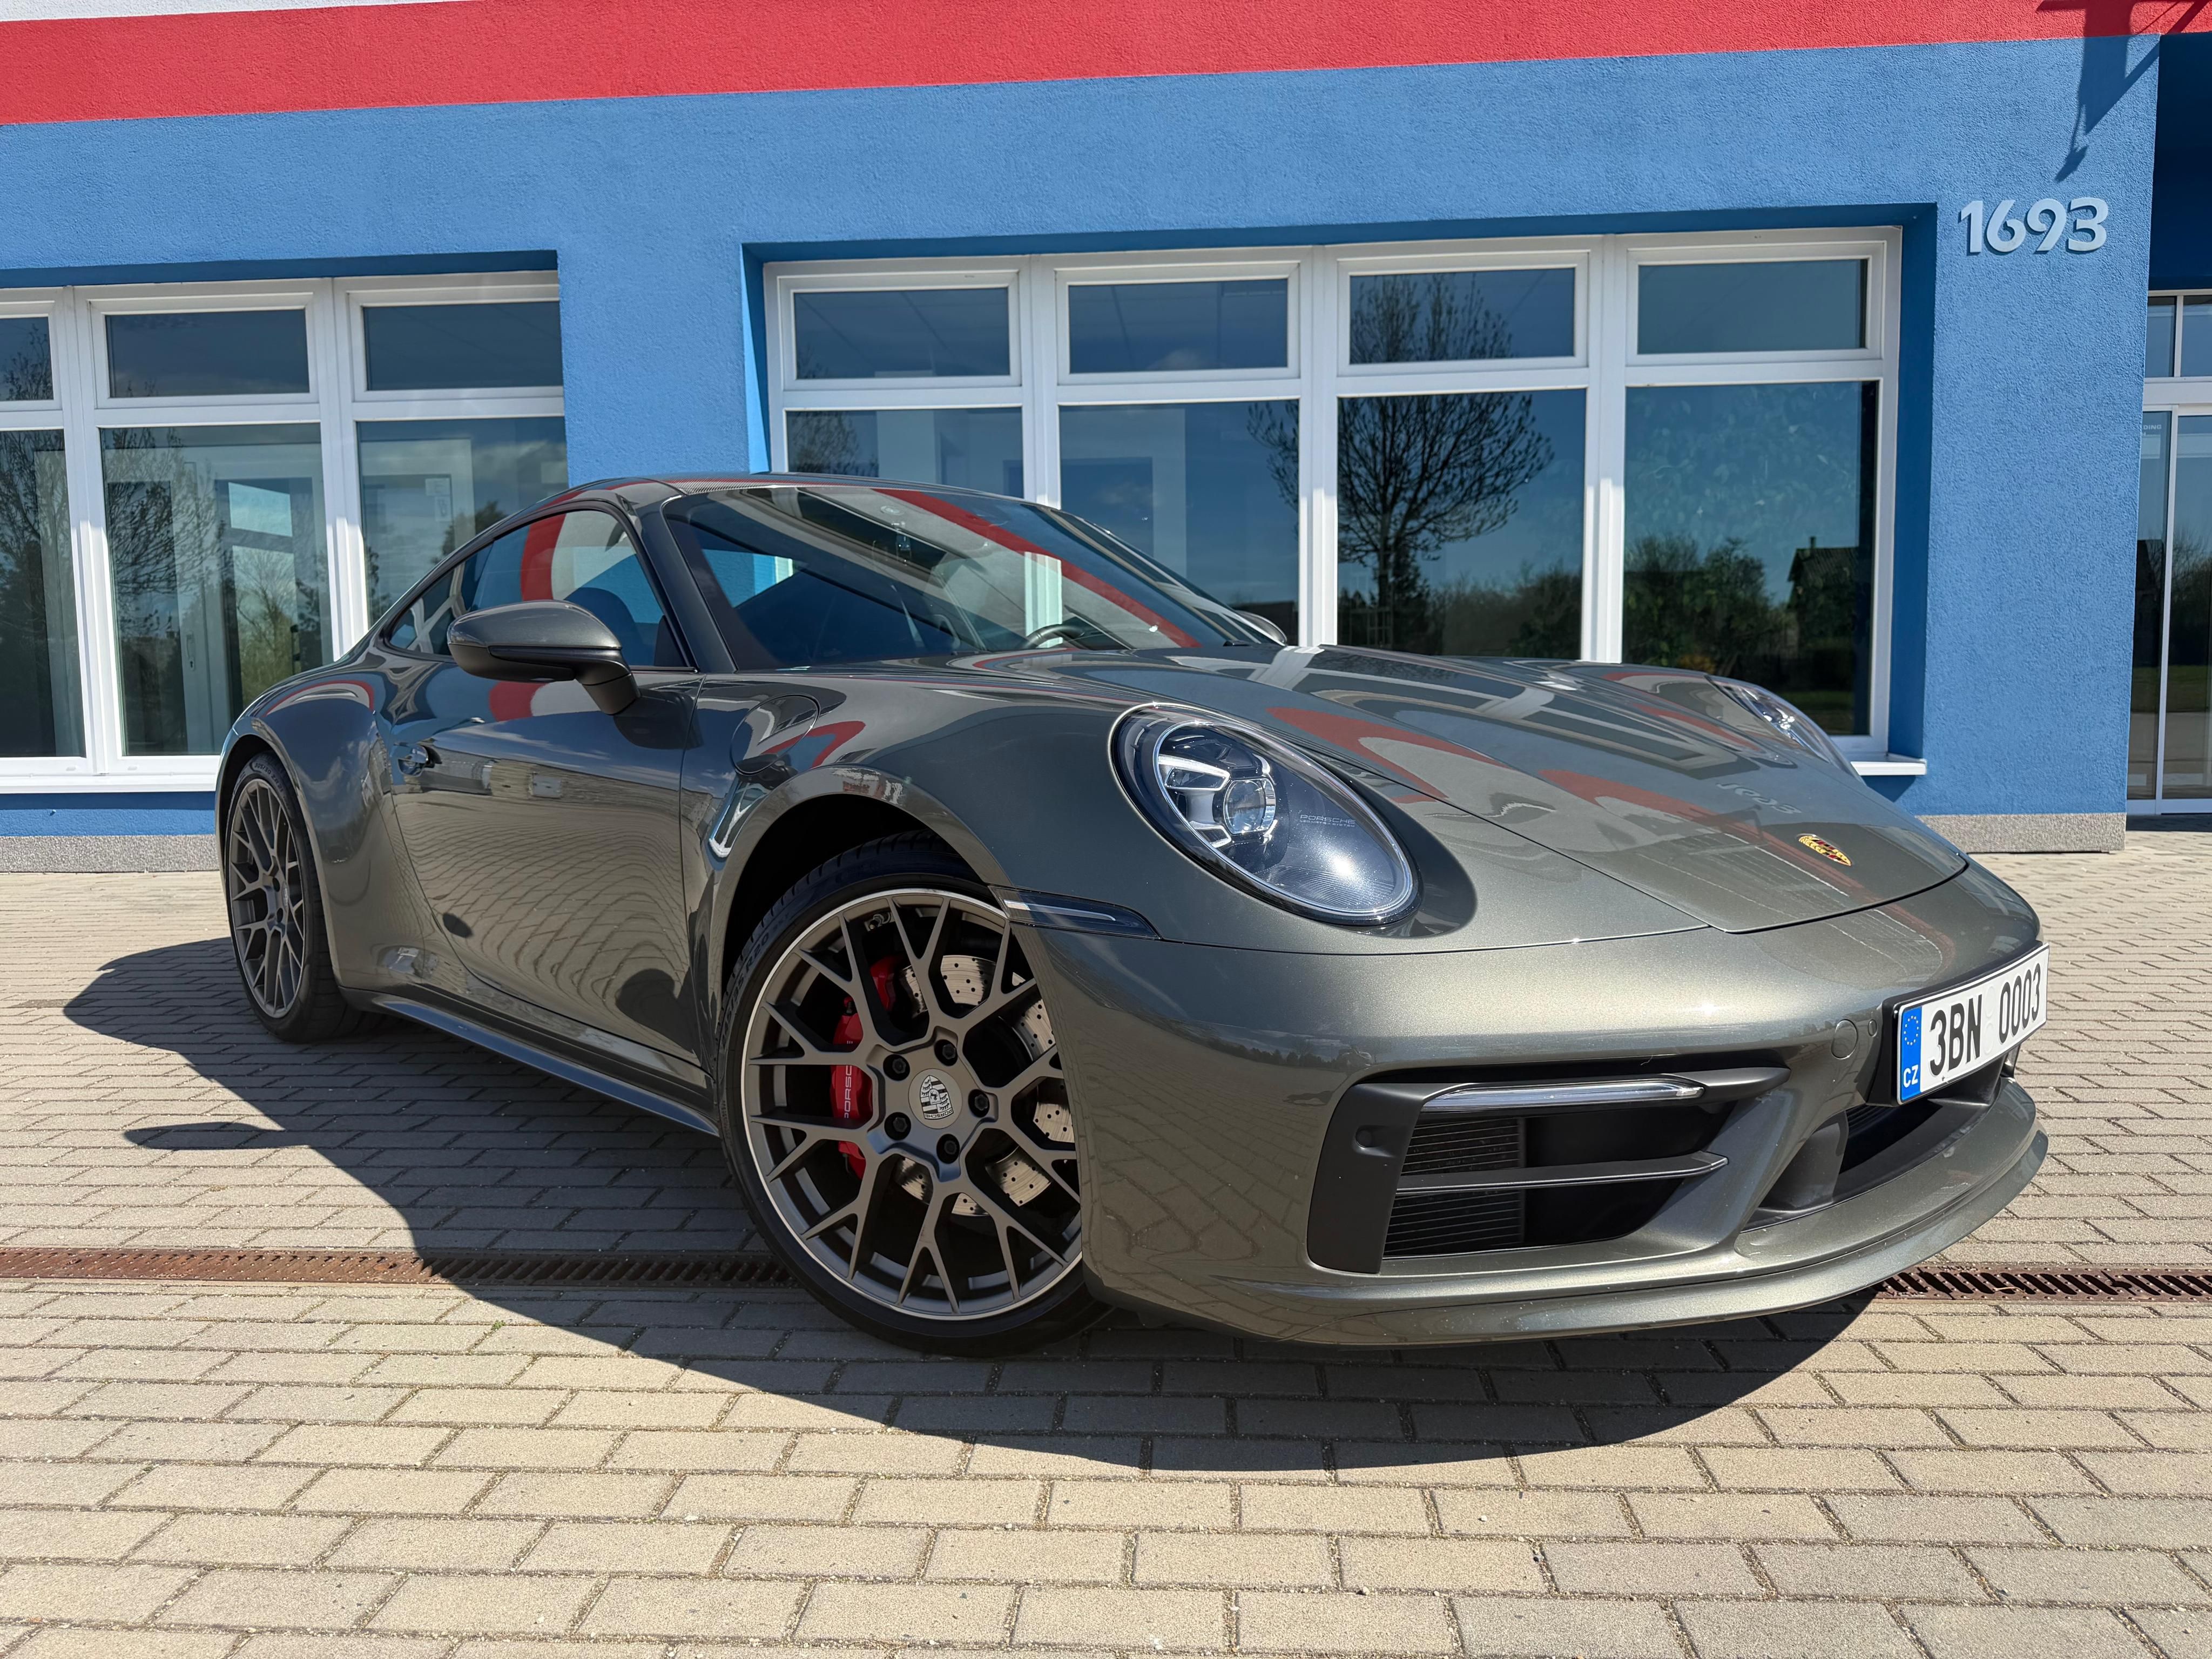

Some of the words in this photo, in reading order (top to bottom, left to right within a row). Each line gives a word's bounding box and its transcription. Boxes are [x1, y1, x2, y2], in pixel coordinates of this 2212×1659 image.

[1960, 197, 2108, 253] 1693
[1300, 814, 1356, 825] PORSCHE
[1930, 994, 1982, 1076] 3BN
[1999, 963, 2041, 1044] 0003
[1903, 1064, 1919, 1088] CZ
[925, 1109, 953, 1118] PORSCHE
